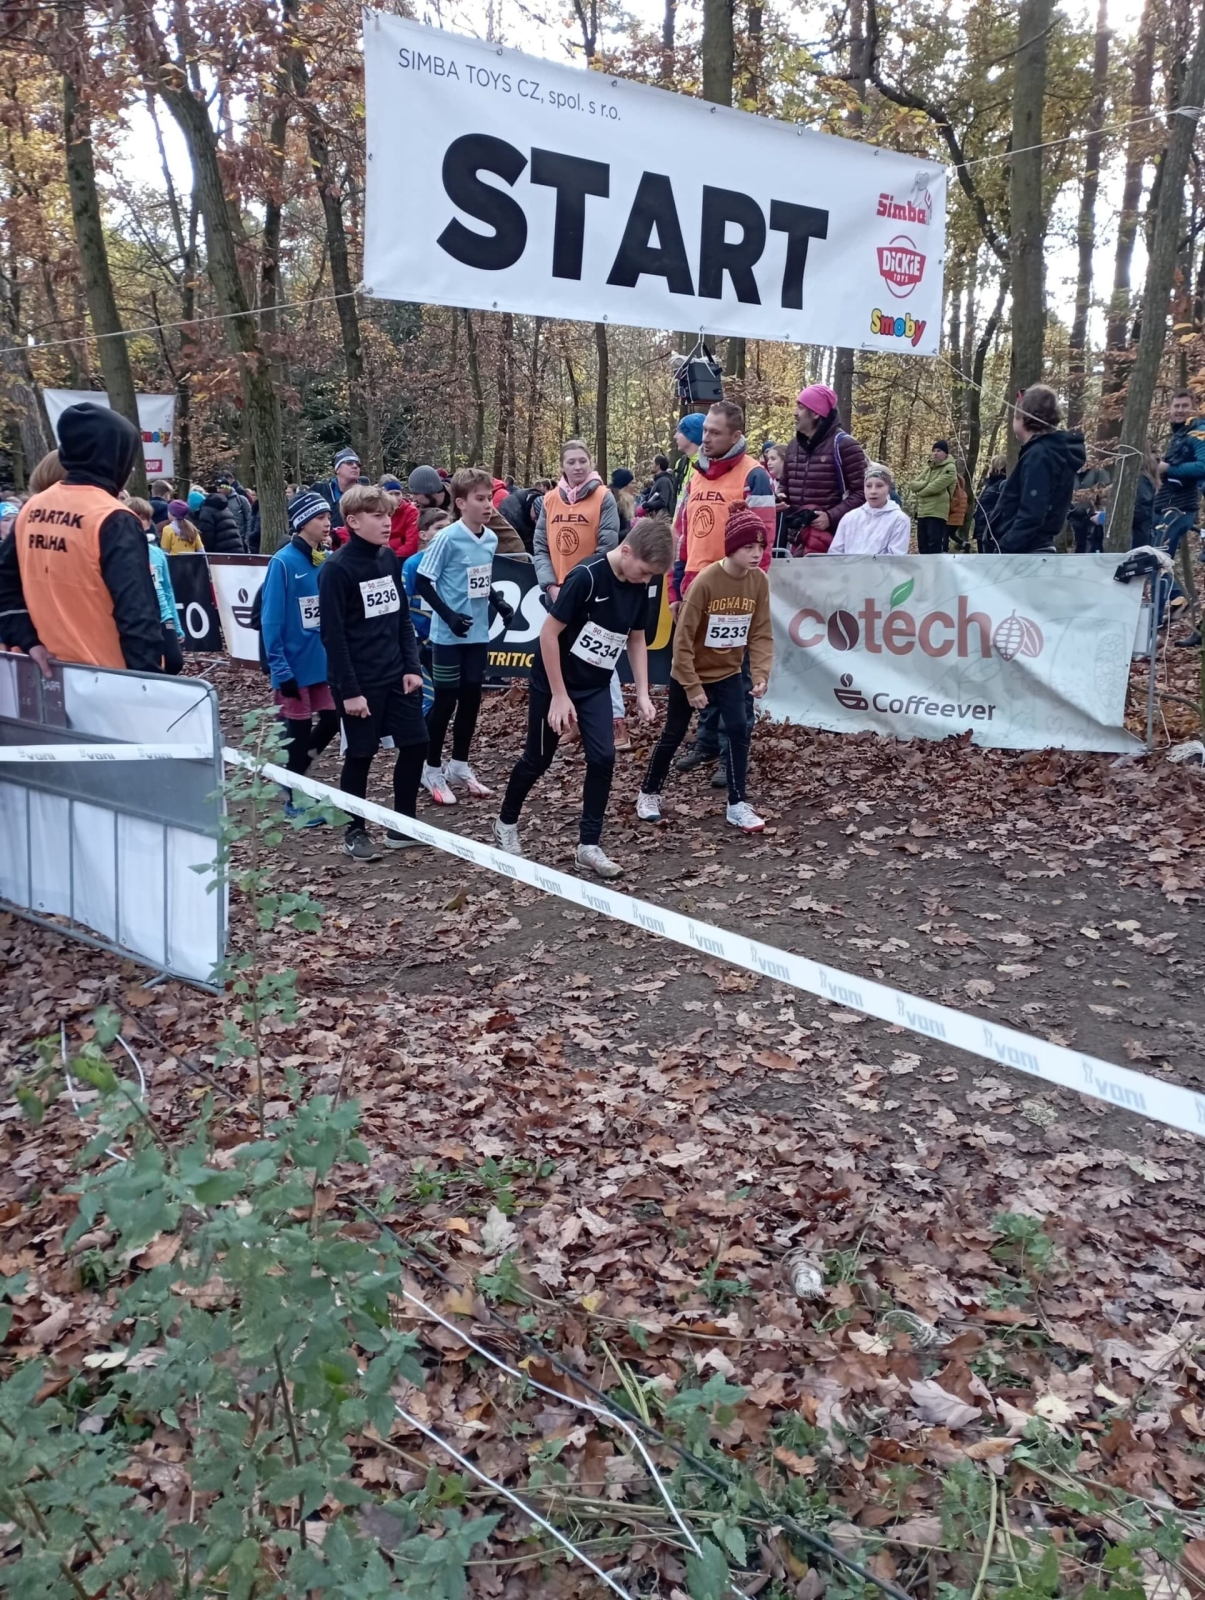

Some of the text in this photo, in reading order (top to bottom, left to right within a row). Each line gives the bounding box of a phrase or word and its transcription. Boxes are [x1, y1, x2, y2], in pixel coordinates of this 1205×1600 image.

[398, 48, 621, 121] SIMBA TOYS CZ, spol. s r.o.
[876, 192, 927, 225] Simba
[436, 133, 830, 310] START
[893, 273, 909, 283] TOYS
[870, 308, 927, 347] Smoby
[140, 428, 171, 448] moby
[145, 461, 160, 470] OUP
[690, 491, 726, 502] ALEA
[28, 509, 85, 529] SPARTAK
[551, 514, 589, 524] ALEA
[470, 575, 491, 589] 523
[366, 588, 397, 607] 5236
[304, 606, 320, 619] 52
[710, 626, 748, 639] 5233
[580, 634, 619, 659] 5234
[872, 692, 997, 721] Coffeever
